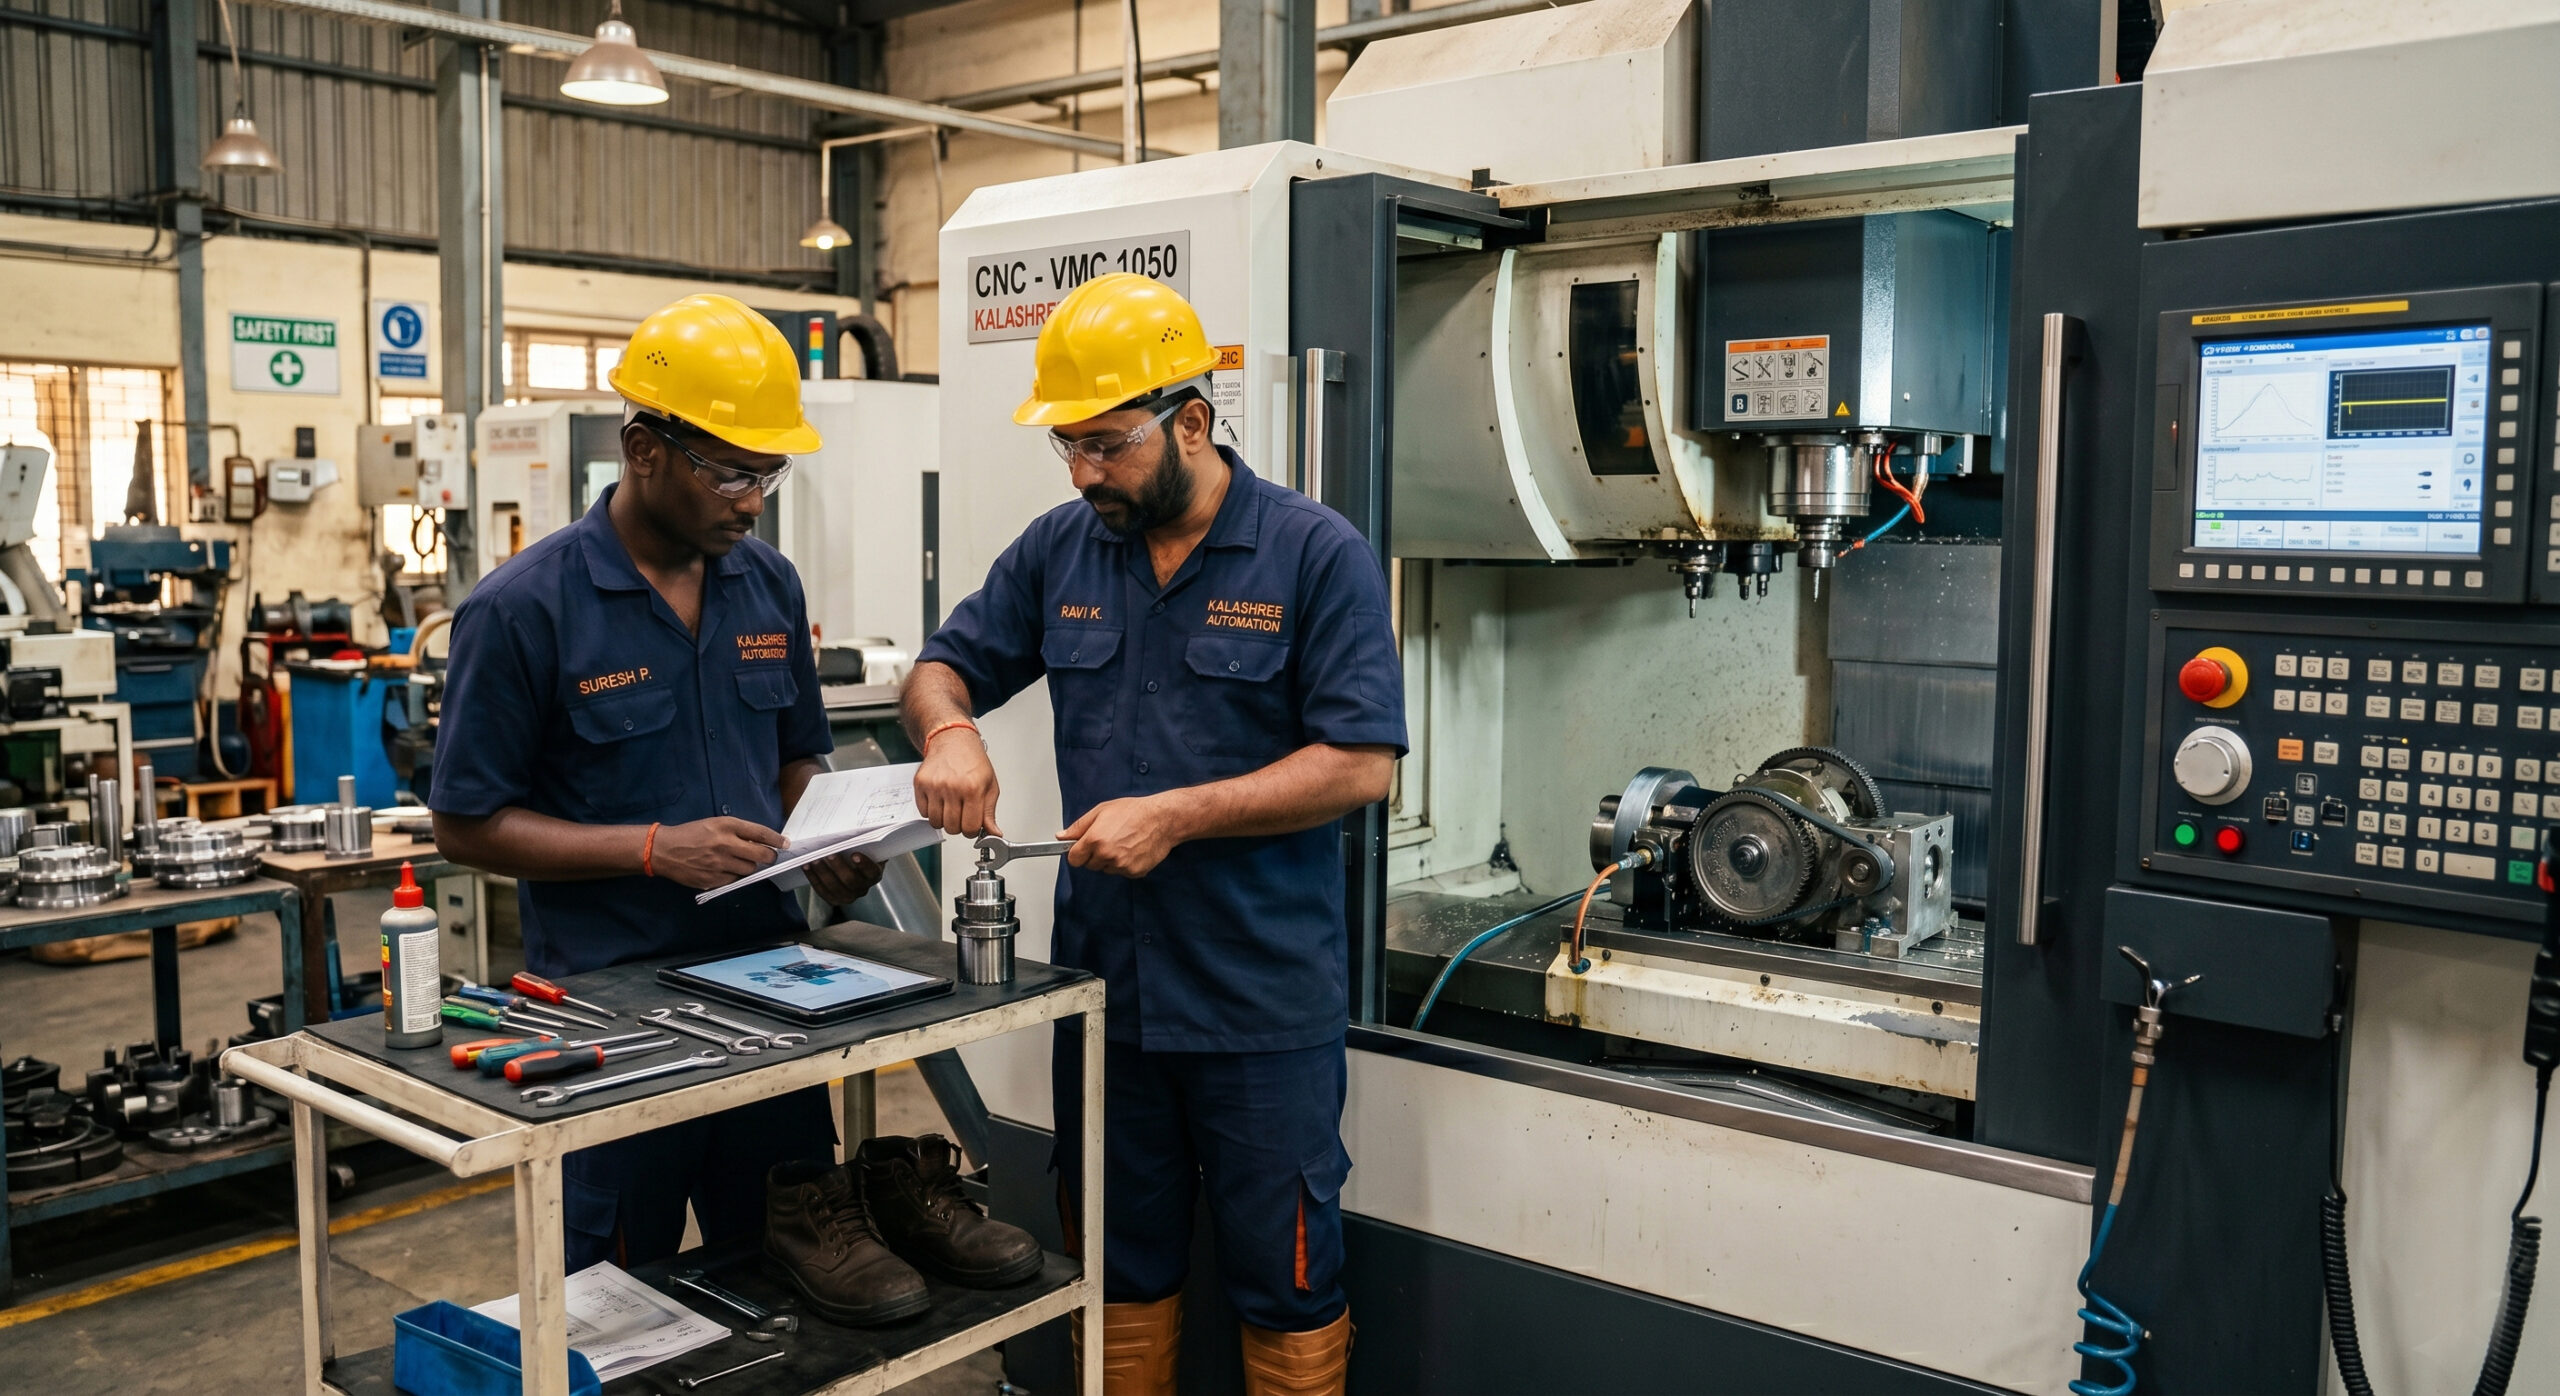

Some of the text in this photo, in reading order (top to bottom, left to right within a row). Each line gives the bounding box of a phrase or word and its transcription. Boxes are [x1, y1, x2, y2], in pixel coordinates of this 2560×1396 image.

[975, 261, 1027, 298] CNC
[1050, 252, 1107, 290] VMC
[1116, 243, 1177, 280] 1050
[974, 301, 1060, 331] KALASHRE
[235, 319, 335, 344] SAFETY FIRST
[1061, 605, 1103, 620] RAVI K.
[1207, 600, 1284, 619] KALASHREE
[1206, 614, 1281, 632] AUTOMATION
[579, 667, 652, 695] SURESH P.
[2430, 757, 2494, 773] 7 8 9
[2428, 791, 2492, 807] 4 5 6
[2426, 823, 2489, 840] 1 2 3
[2423, 856, 2431, 867] 0
